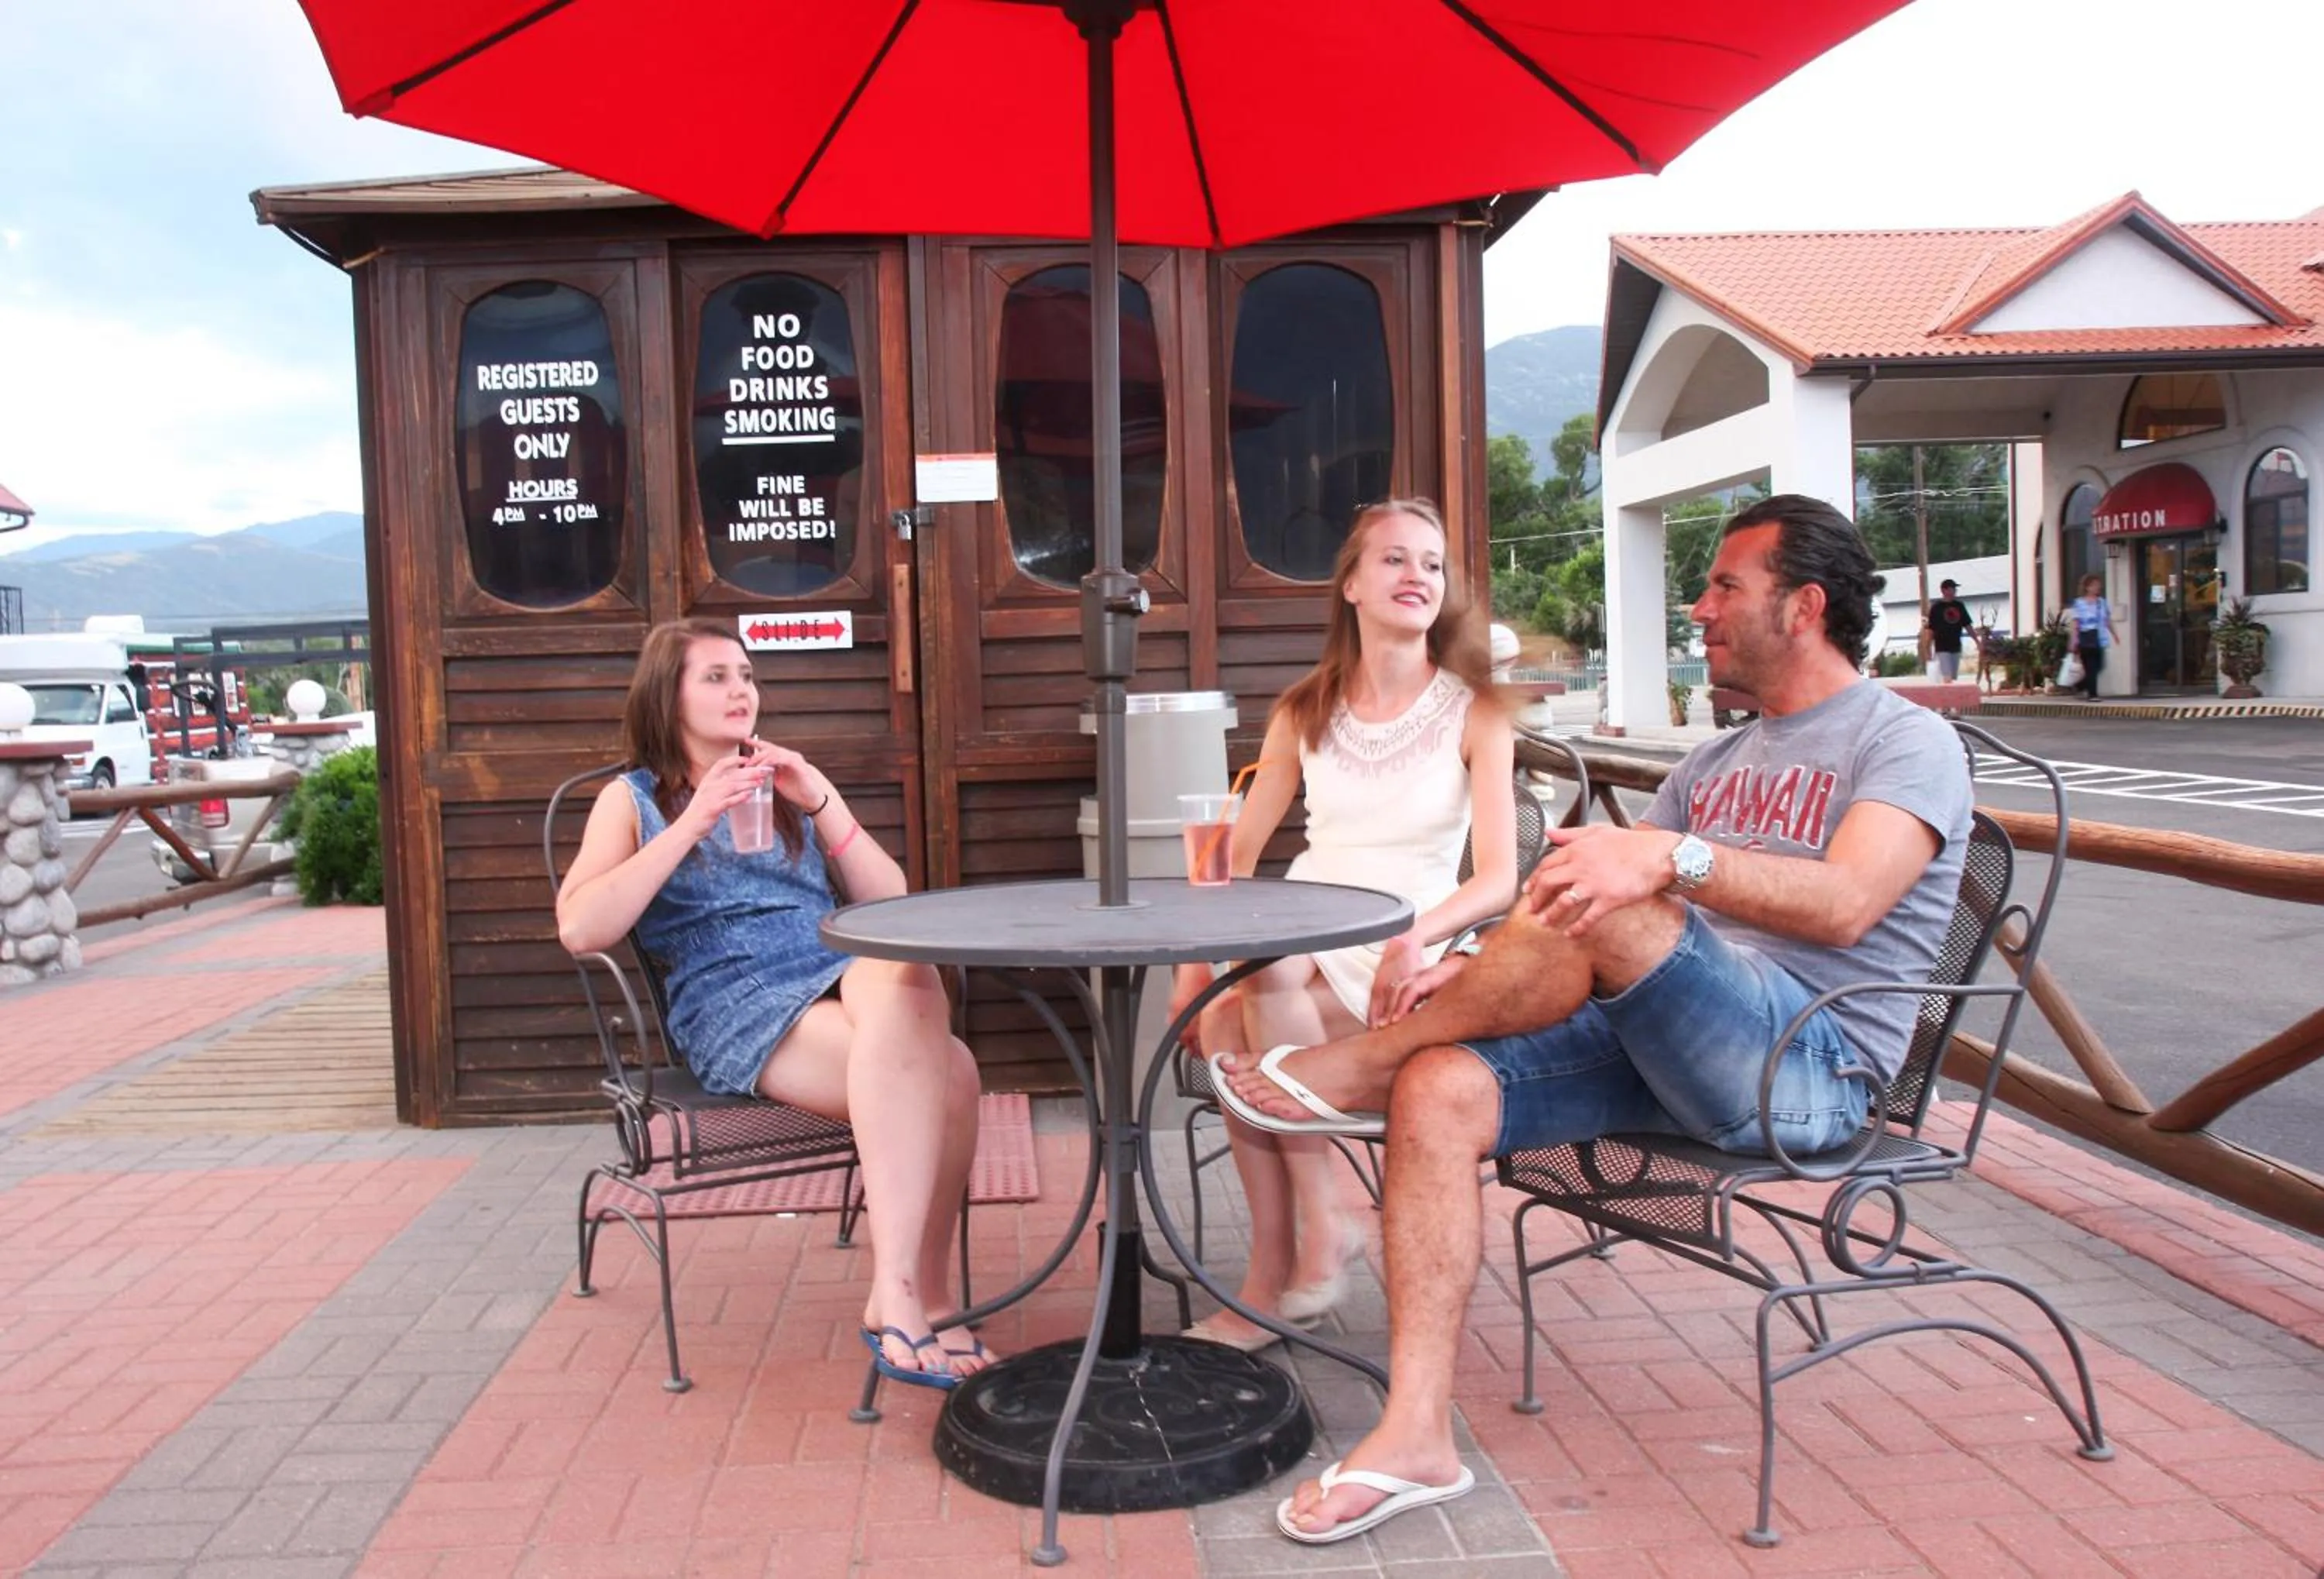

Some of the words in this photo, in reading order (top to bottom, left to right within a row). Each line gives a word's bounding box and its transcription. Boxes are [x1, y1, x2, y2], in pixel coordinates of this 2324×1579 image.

[753, 314, 800, 339] NO
[741, 345, 814, 371] FOOD
[477, 360, 599, 390] REGISTERED
[729, 375, 829, 402] DRINKS
[500, 396, 580, 425] GUESTS
[724, 406, 836, 434] SMOKING
[514, 432, 571, 460] ONLY
[508, 478, 579, 499] HOURS
[757, 475, 805, 495] FINE
[738, 498, 792, 518] WILL
[798, 497, 825, 517] BE
[729, 520, 836, 542] IMPOSED!
[761, 619, 820, 641] SLIDE
[1689, 765, 1837, 850] HAWAII
